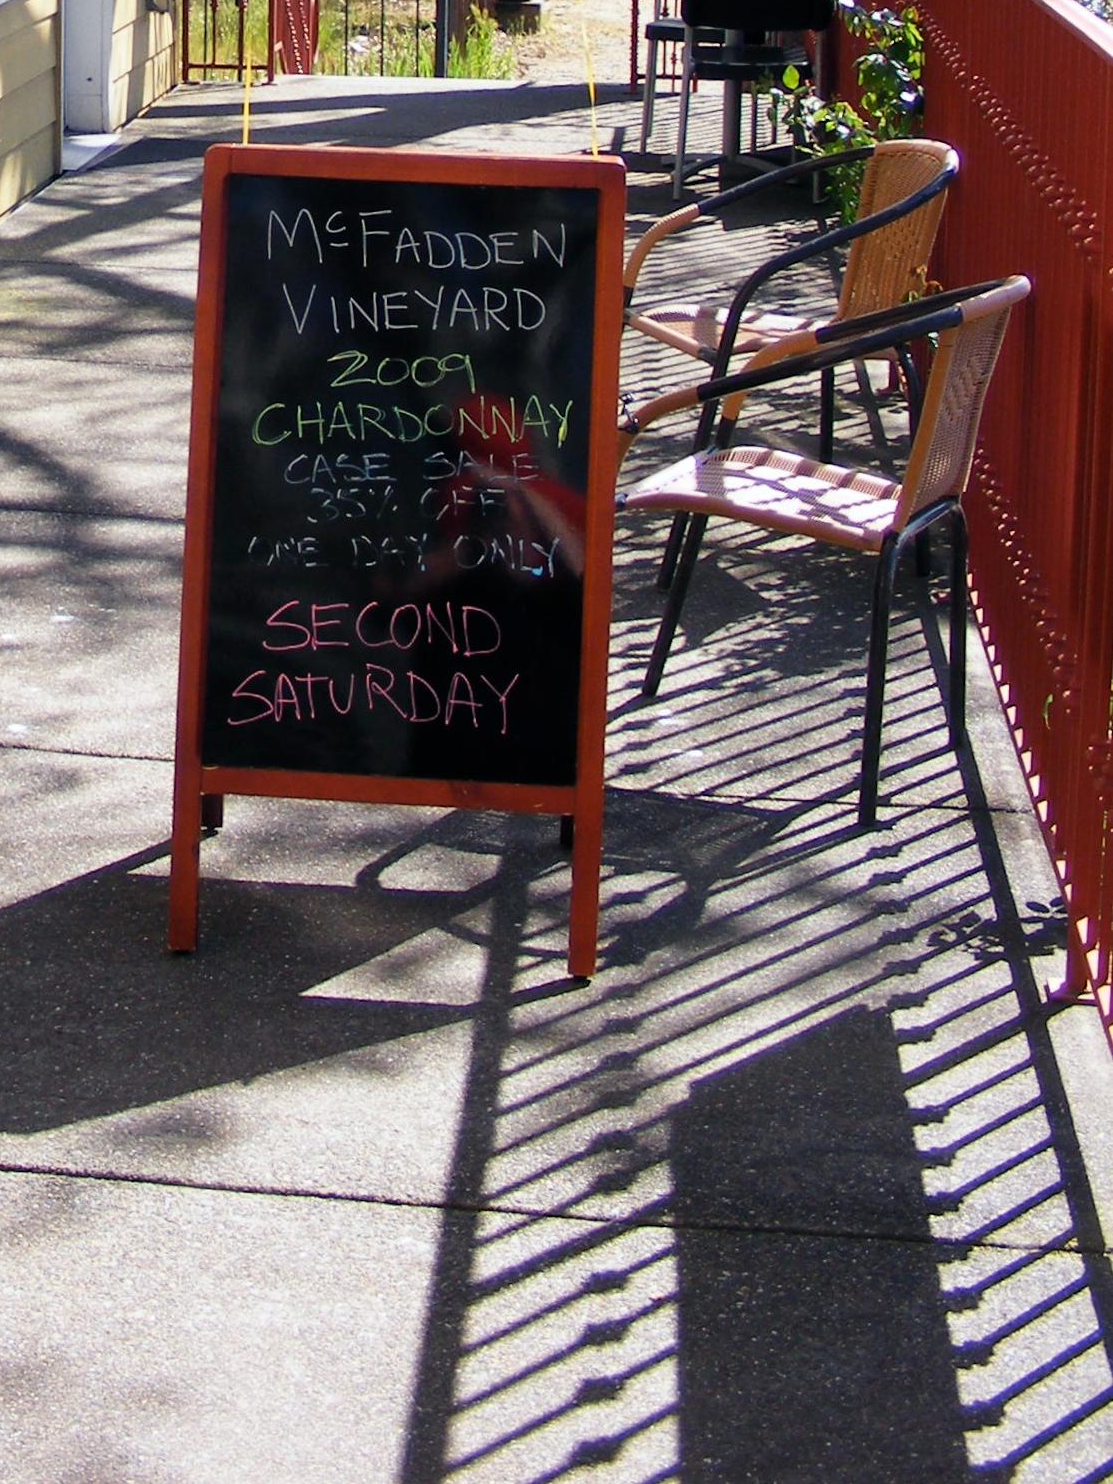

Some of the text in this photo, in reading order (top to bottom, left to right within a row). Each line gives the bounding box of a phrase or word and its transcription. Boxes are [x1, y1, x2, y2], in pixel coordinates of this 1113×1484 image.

[282, 282, 547, 334] VINEYARD
[328, 349, 477, 394] 2009
[250, 395, 575, 448] CHARDONNAY
[283, 450, 539, 484] CASE SALE
[420, 485, 506, 521] OFF
[247, 532, 560, 578] ONE DAY ONLY
[261, 600, 502, 657] SECOND
[226, 664, 521, 736] SATURDAY
